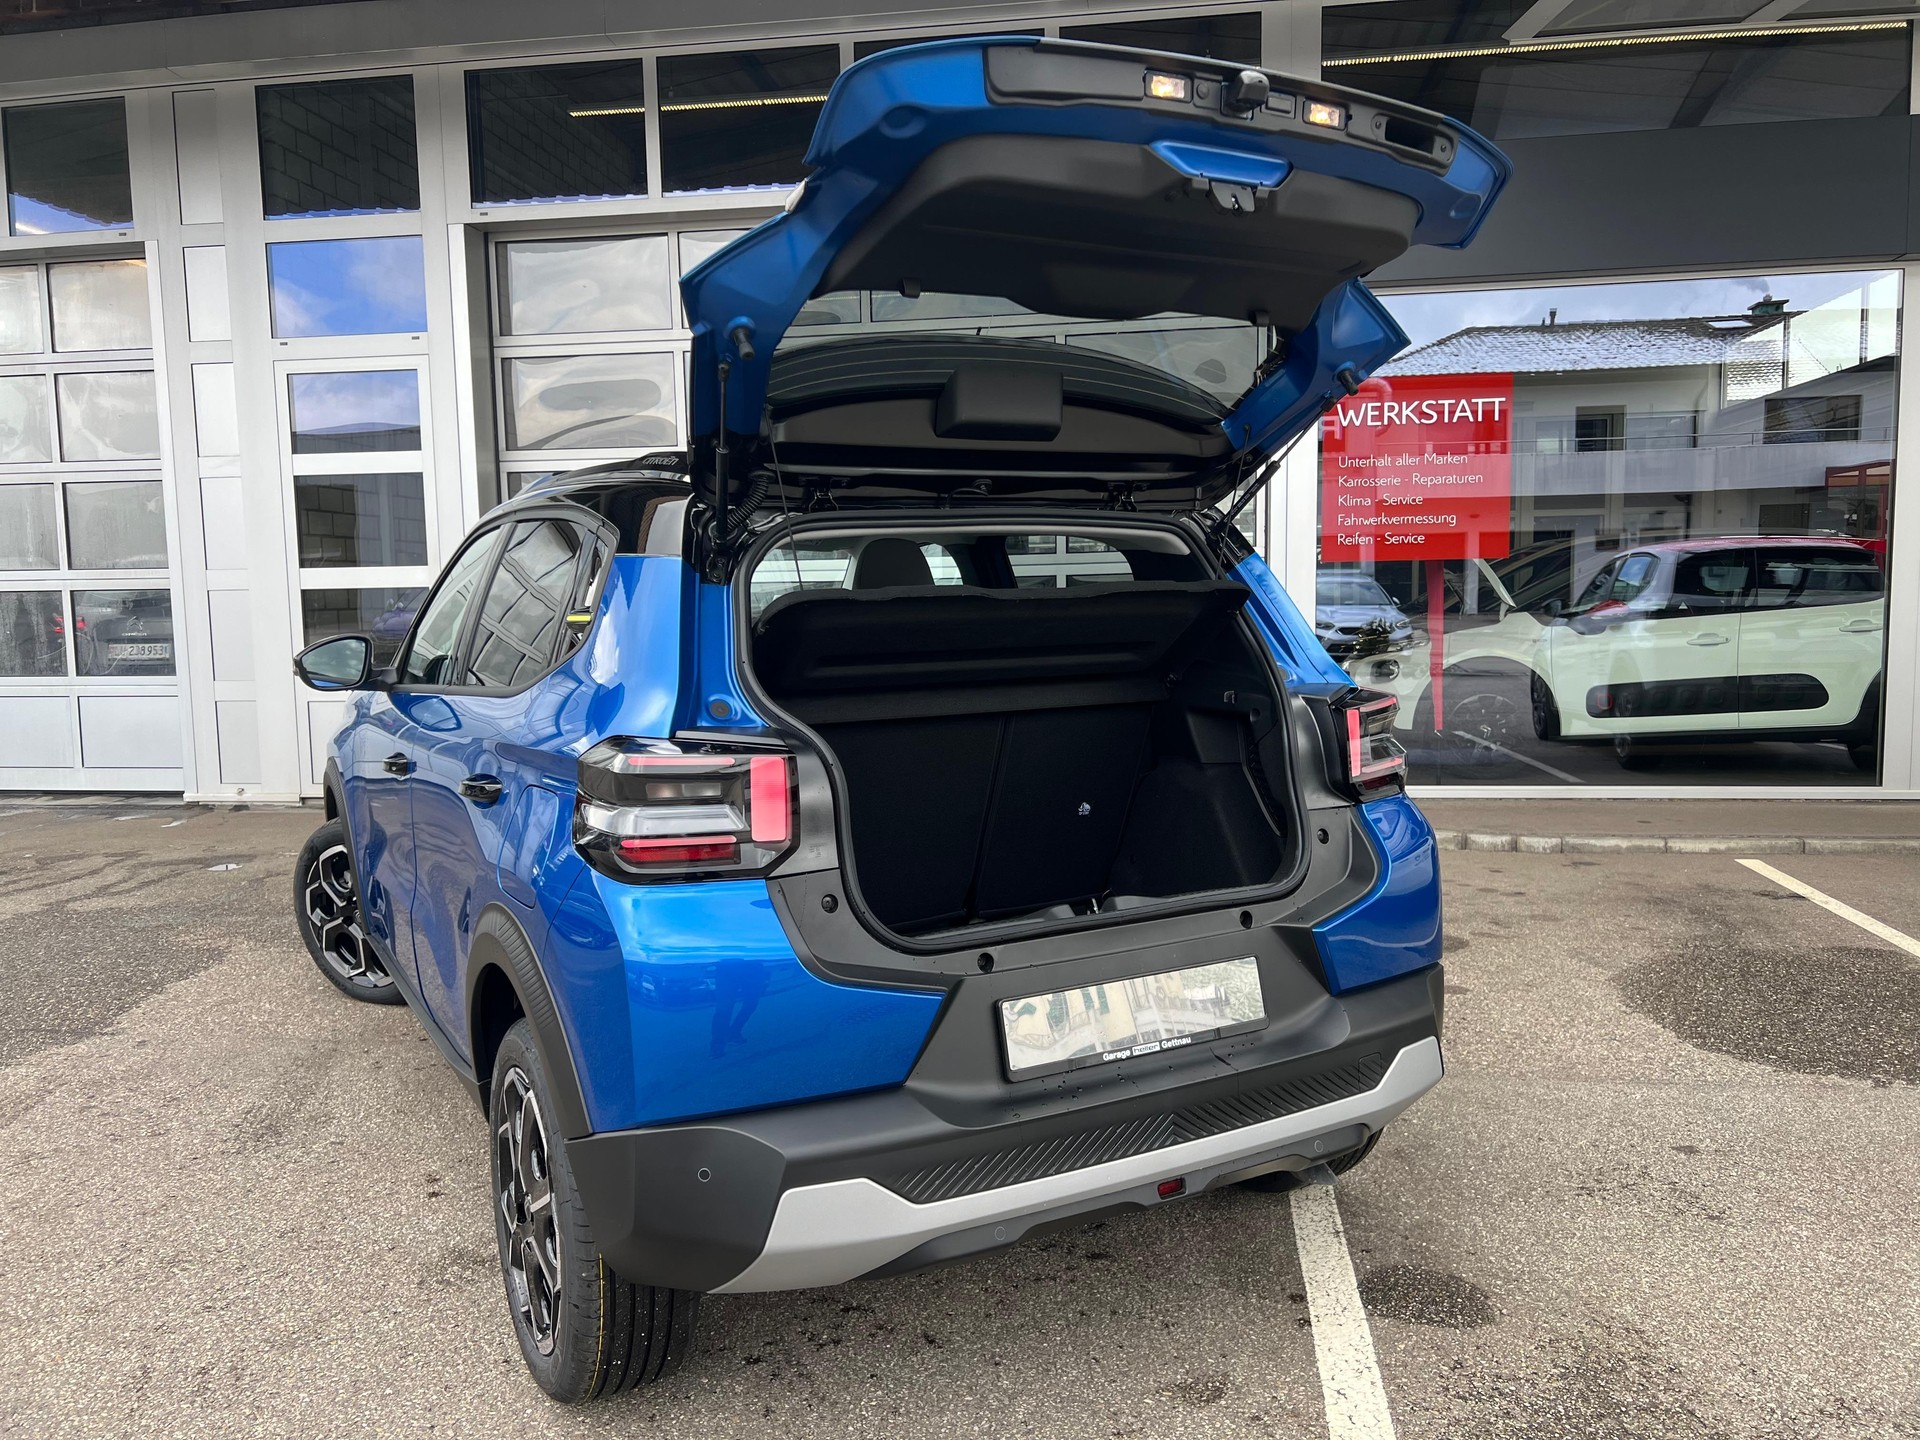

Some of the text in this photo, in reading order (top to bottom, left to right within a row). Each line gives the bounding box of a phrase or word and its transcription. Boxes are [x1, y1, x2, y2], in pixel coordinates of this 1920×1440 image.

[1336, 397, 1506, 427] WERKSTATT
[1338, 452, 1468, 468] Unterhalt aller Marken
[1338, 475, 1401, 488] Karrosserie
[1412, 472, 1483, 488] Reparaturen
[1338, 494, 1371, 507] Klima
[1382, 493, 1423, 505] Service
[1337, 512, 1457, 527] Fahrwerkvermessung
[1337, 533, 1373, 546] Reifen
[1384, 532, 1425, 545] Service
[1102, 1049, 1131, 1060] Garage
[1161, 1037, 1191, 1048] Gettnau
